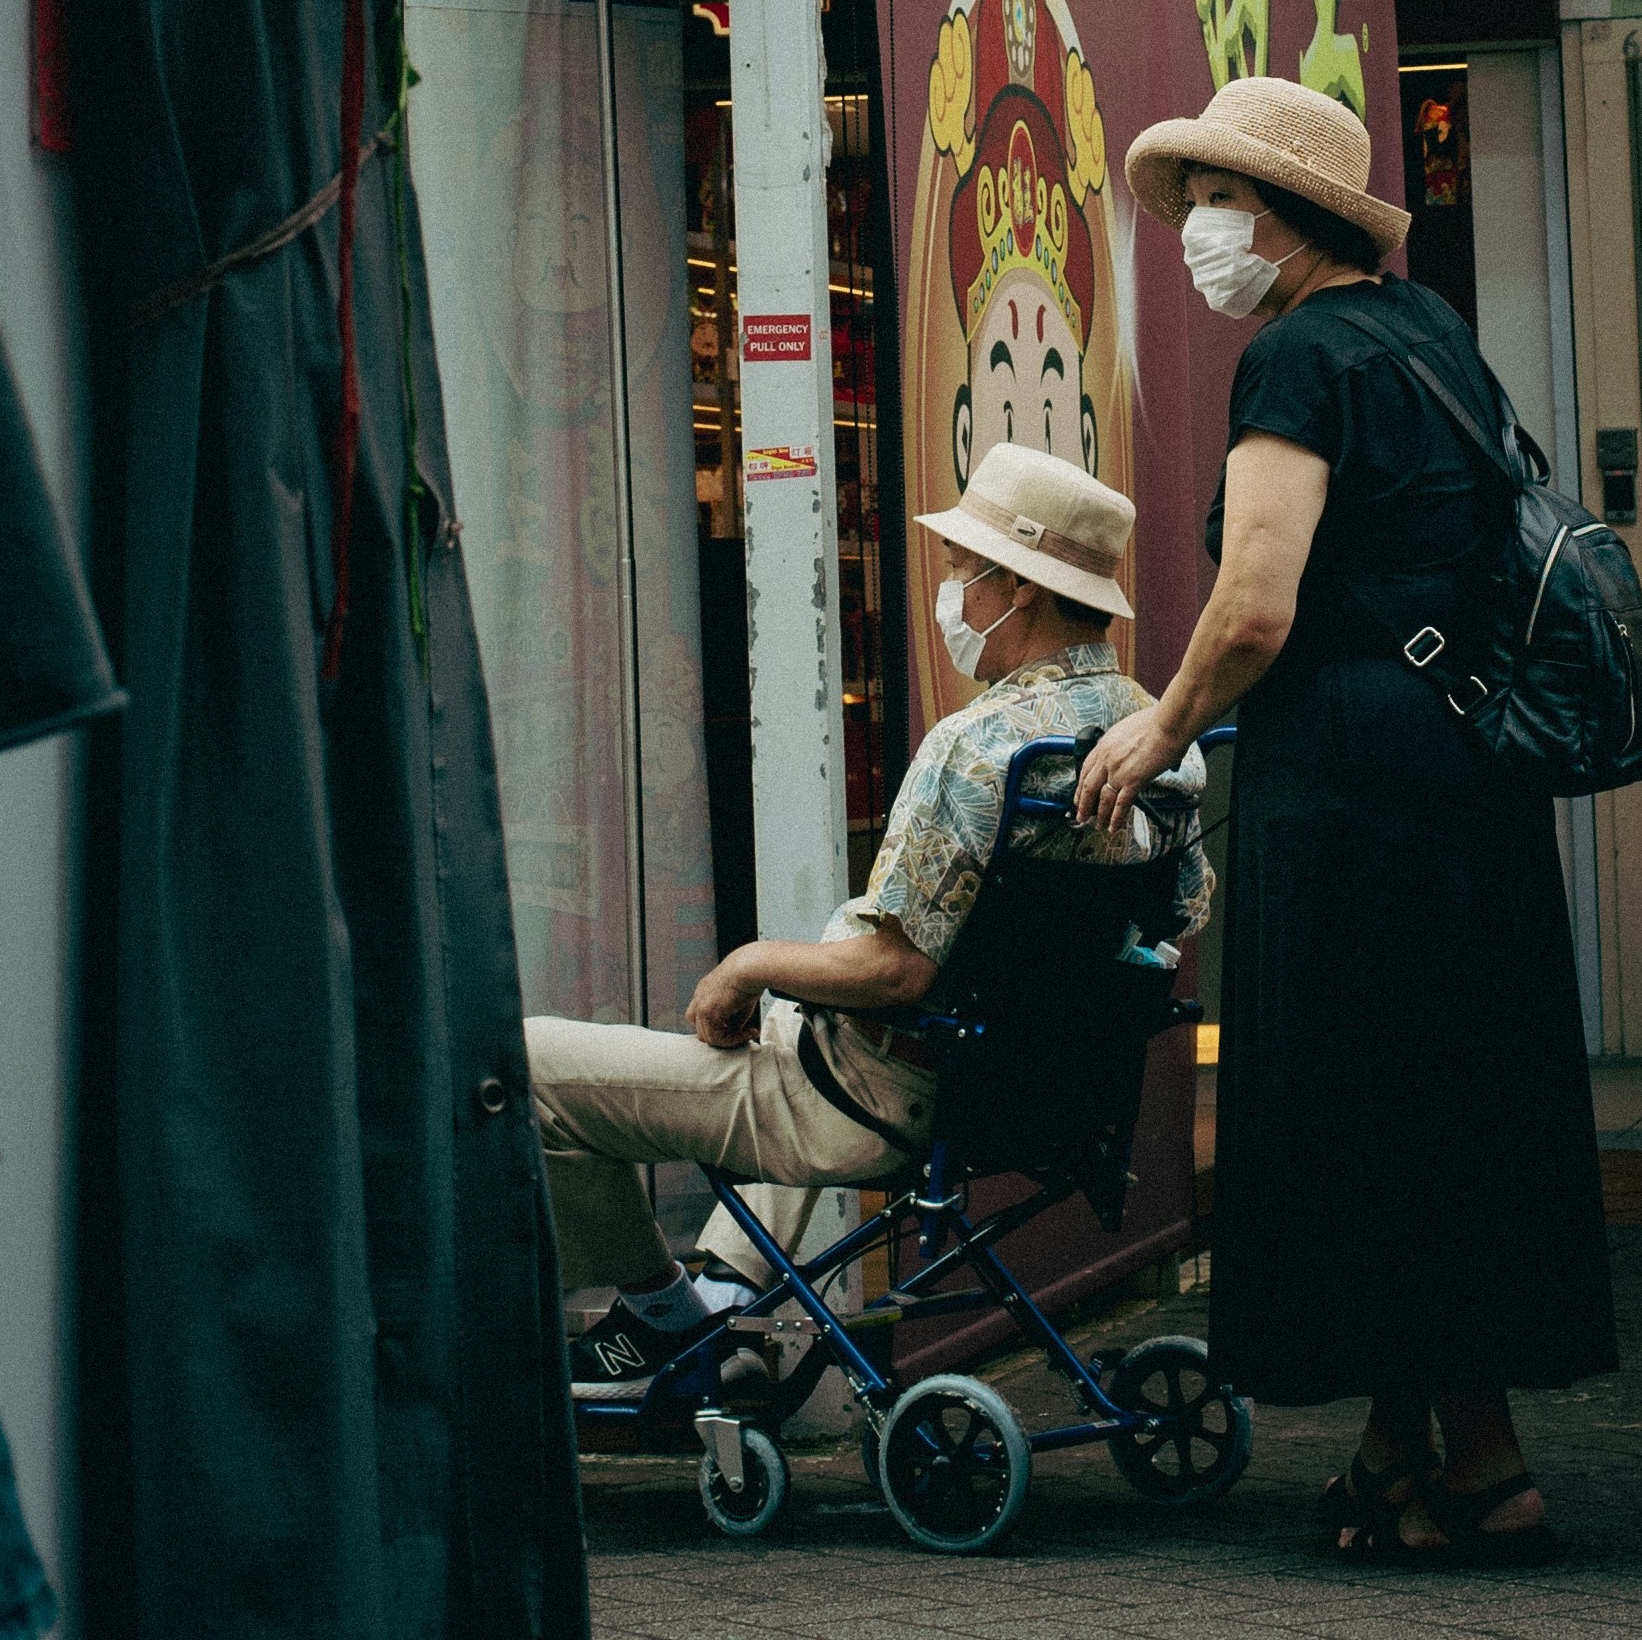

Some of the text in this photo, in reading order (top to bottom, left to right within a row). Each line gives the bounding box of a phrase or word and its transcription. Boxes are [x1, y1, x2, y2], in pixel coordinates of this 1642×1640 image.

[747, 323, 809, 336] EMERGENCY
[750, 340, 806, 353] PULL ONLY
